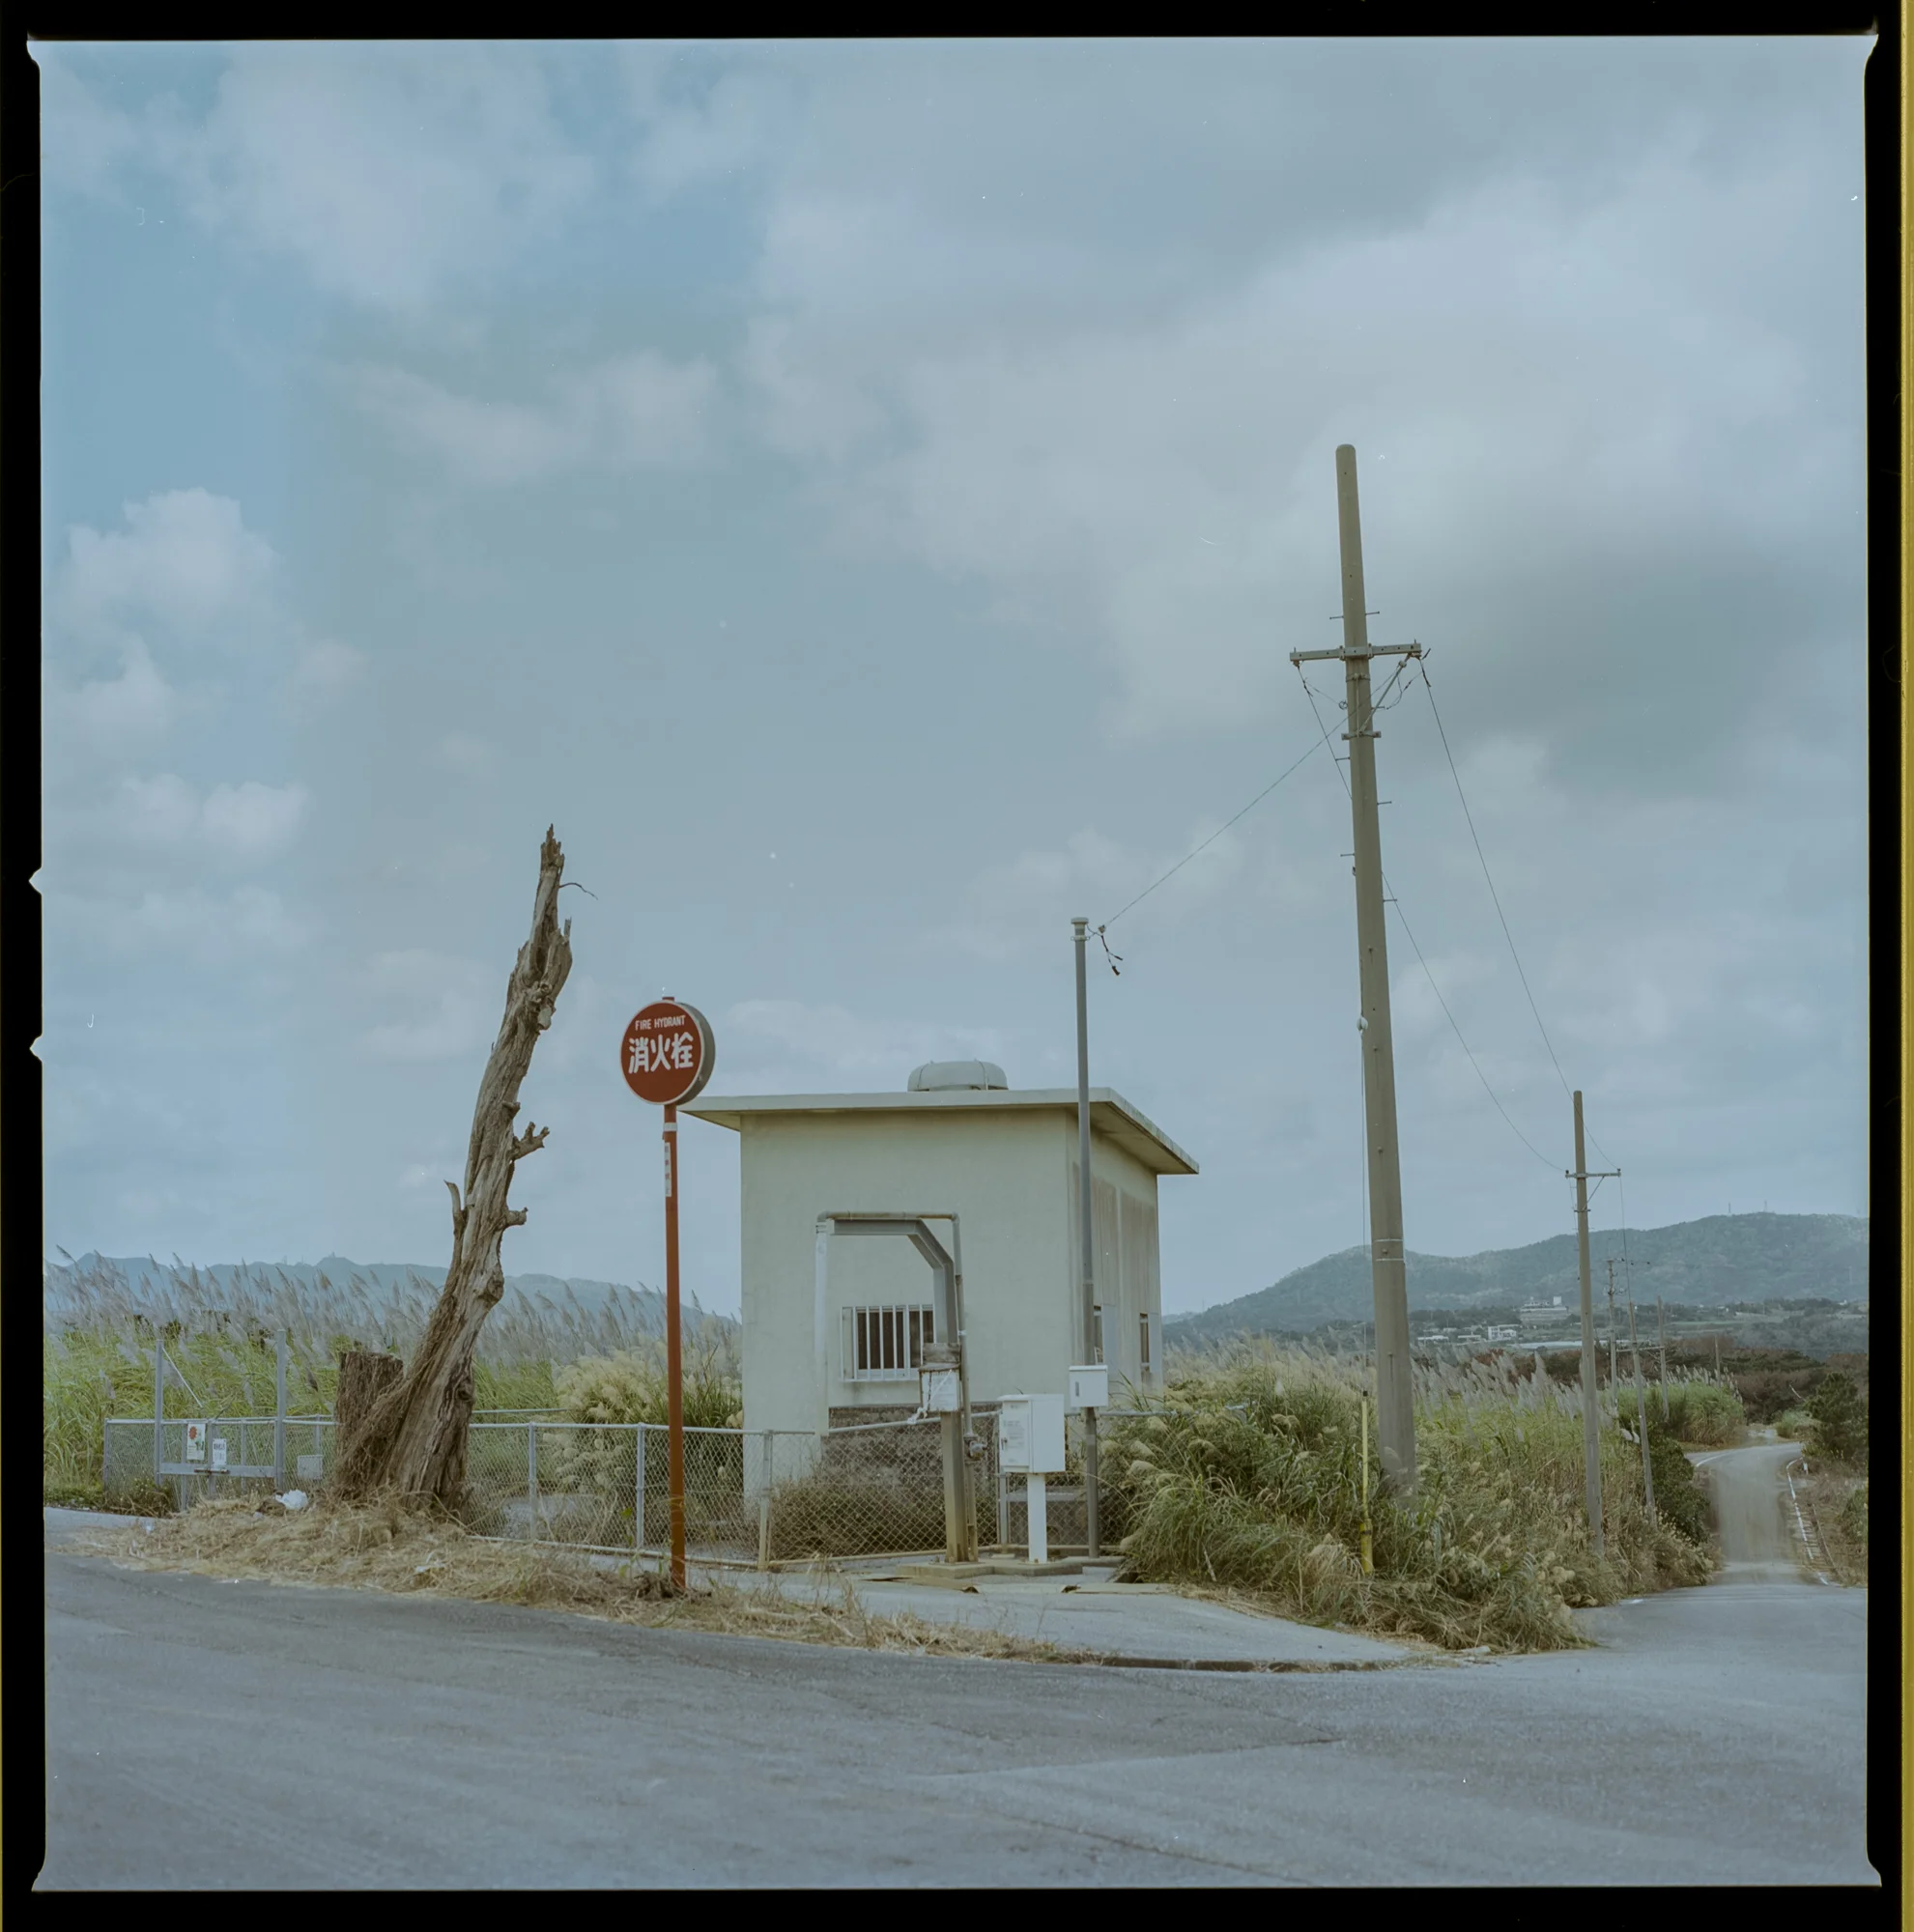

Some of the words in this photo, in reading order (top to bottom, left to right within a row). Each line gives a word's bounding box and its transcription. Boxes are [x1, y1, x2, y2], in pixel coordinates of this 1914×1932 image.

[635, 1018, 652, 1031] FIRE
[653, 1014, 686, 1029] HYDRANT
[628, 1032, 694, 1074] 消火栓
